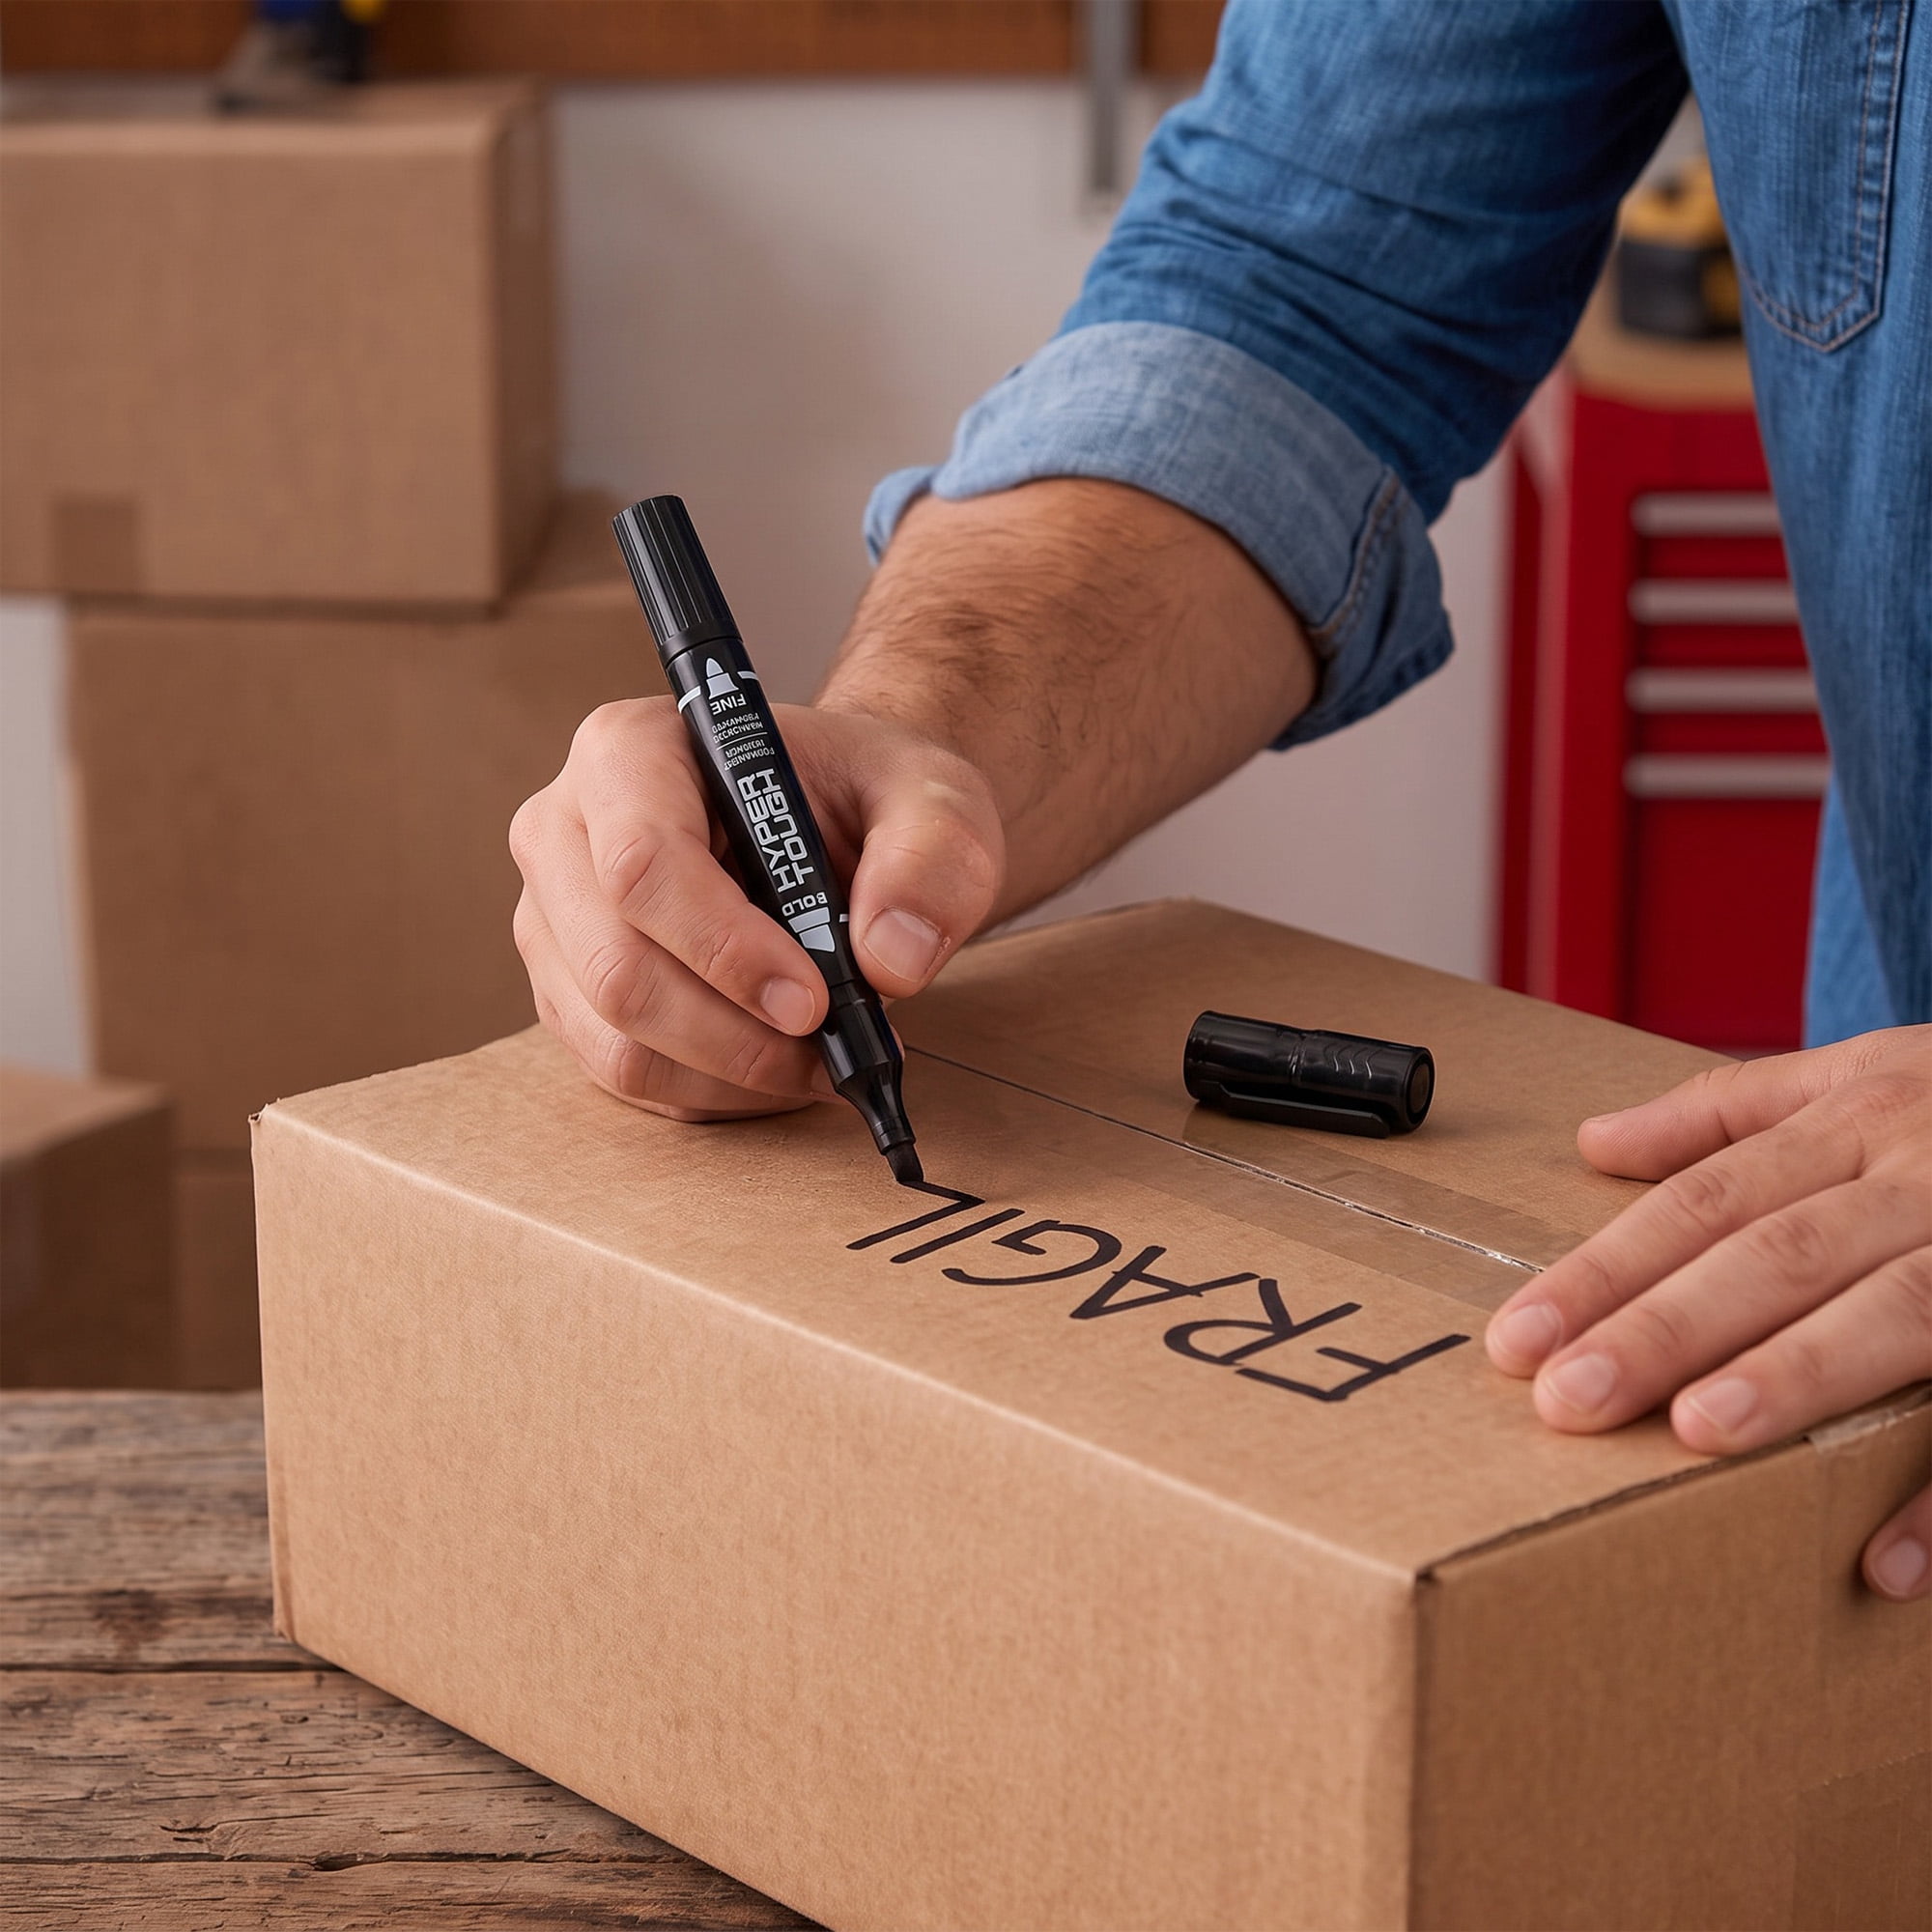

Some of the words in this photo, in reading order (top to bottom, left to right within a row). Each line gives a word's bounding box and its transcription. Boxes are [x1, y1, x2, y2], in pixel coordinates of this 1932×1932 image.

[710, 694, 747, 716] FINE
[736, 774, 797, 893] HYPER
[755, 768, 814, 886] TOUGH
[781, 892, 829, 917] BOLD
[845, 1179, 1471, 1403] FRAGIL
